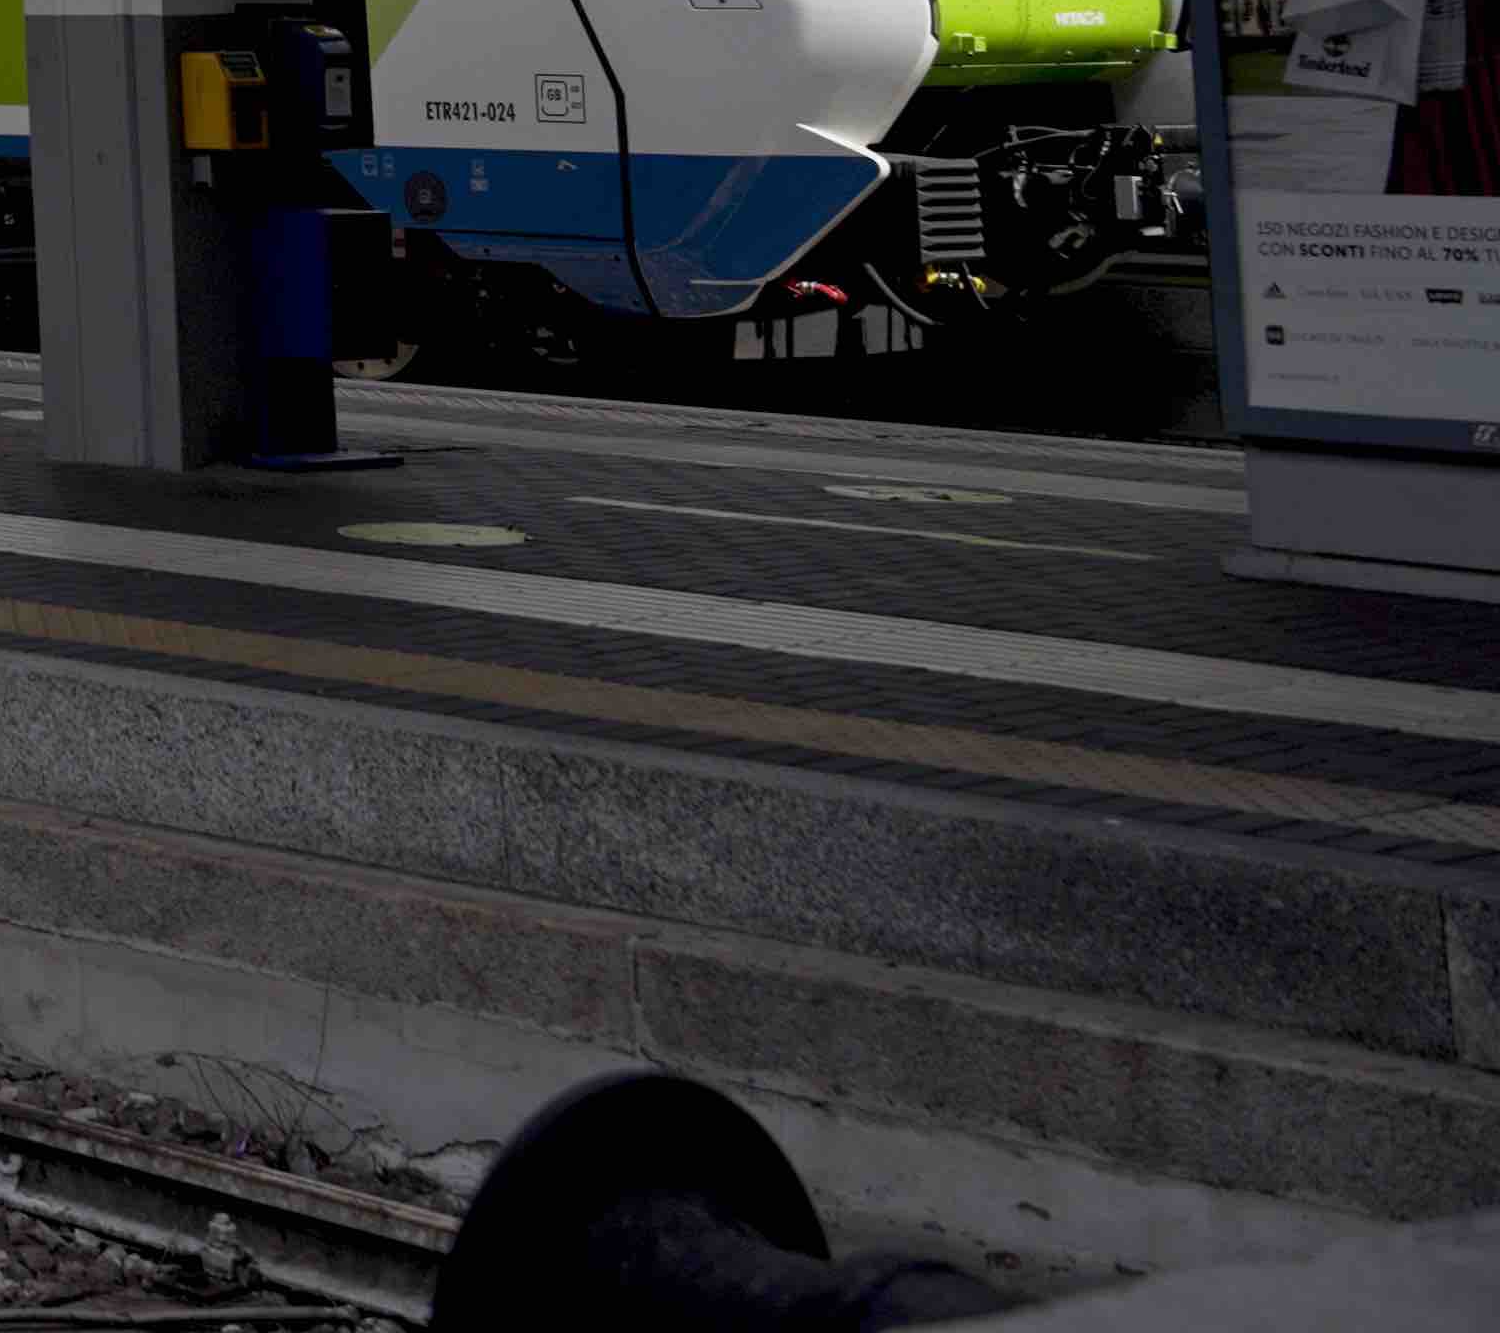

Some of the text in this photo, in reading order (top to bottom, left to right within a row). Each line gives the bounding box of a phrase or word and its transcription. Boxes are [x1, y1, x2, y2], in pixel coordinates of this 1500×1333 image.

[425, 100, 517, 123] ETR421-024
[1257, 221, 1500, 242] 150 NEGOZI FASHION E DESIG
[1257, 242, 1295, 257] CON
[1299, 243, 1365, 259] SCONTI
[1370, 245, 1413, 261] FINO
[1417, 245, 1438, 261] AL
[1443, 246, 1480, 262] 70%
